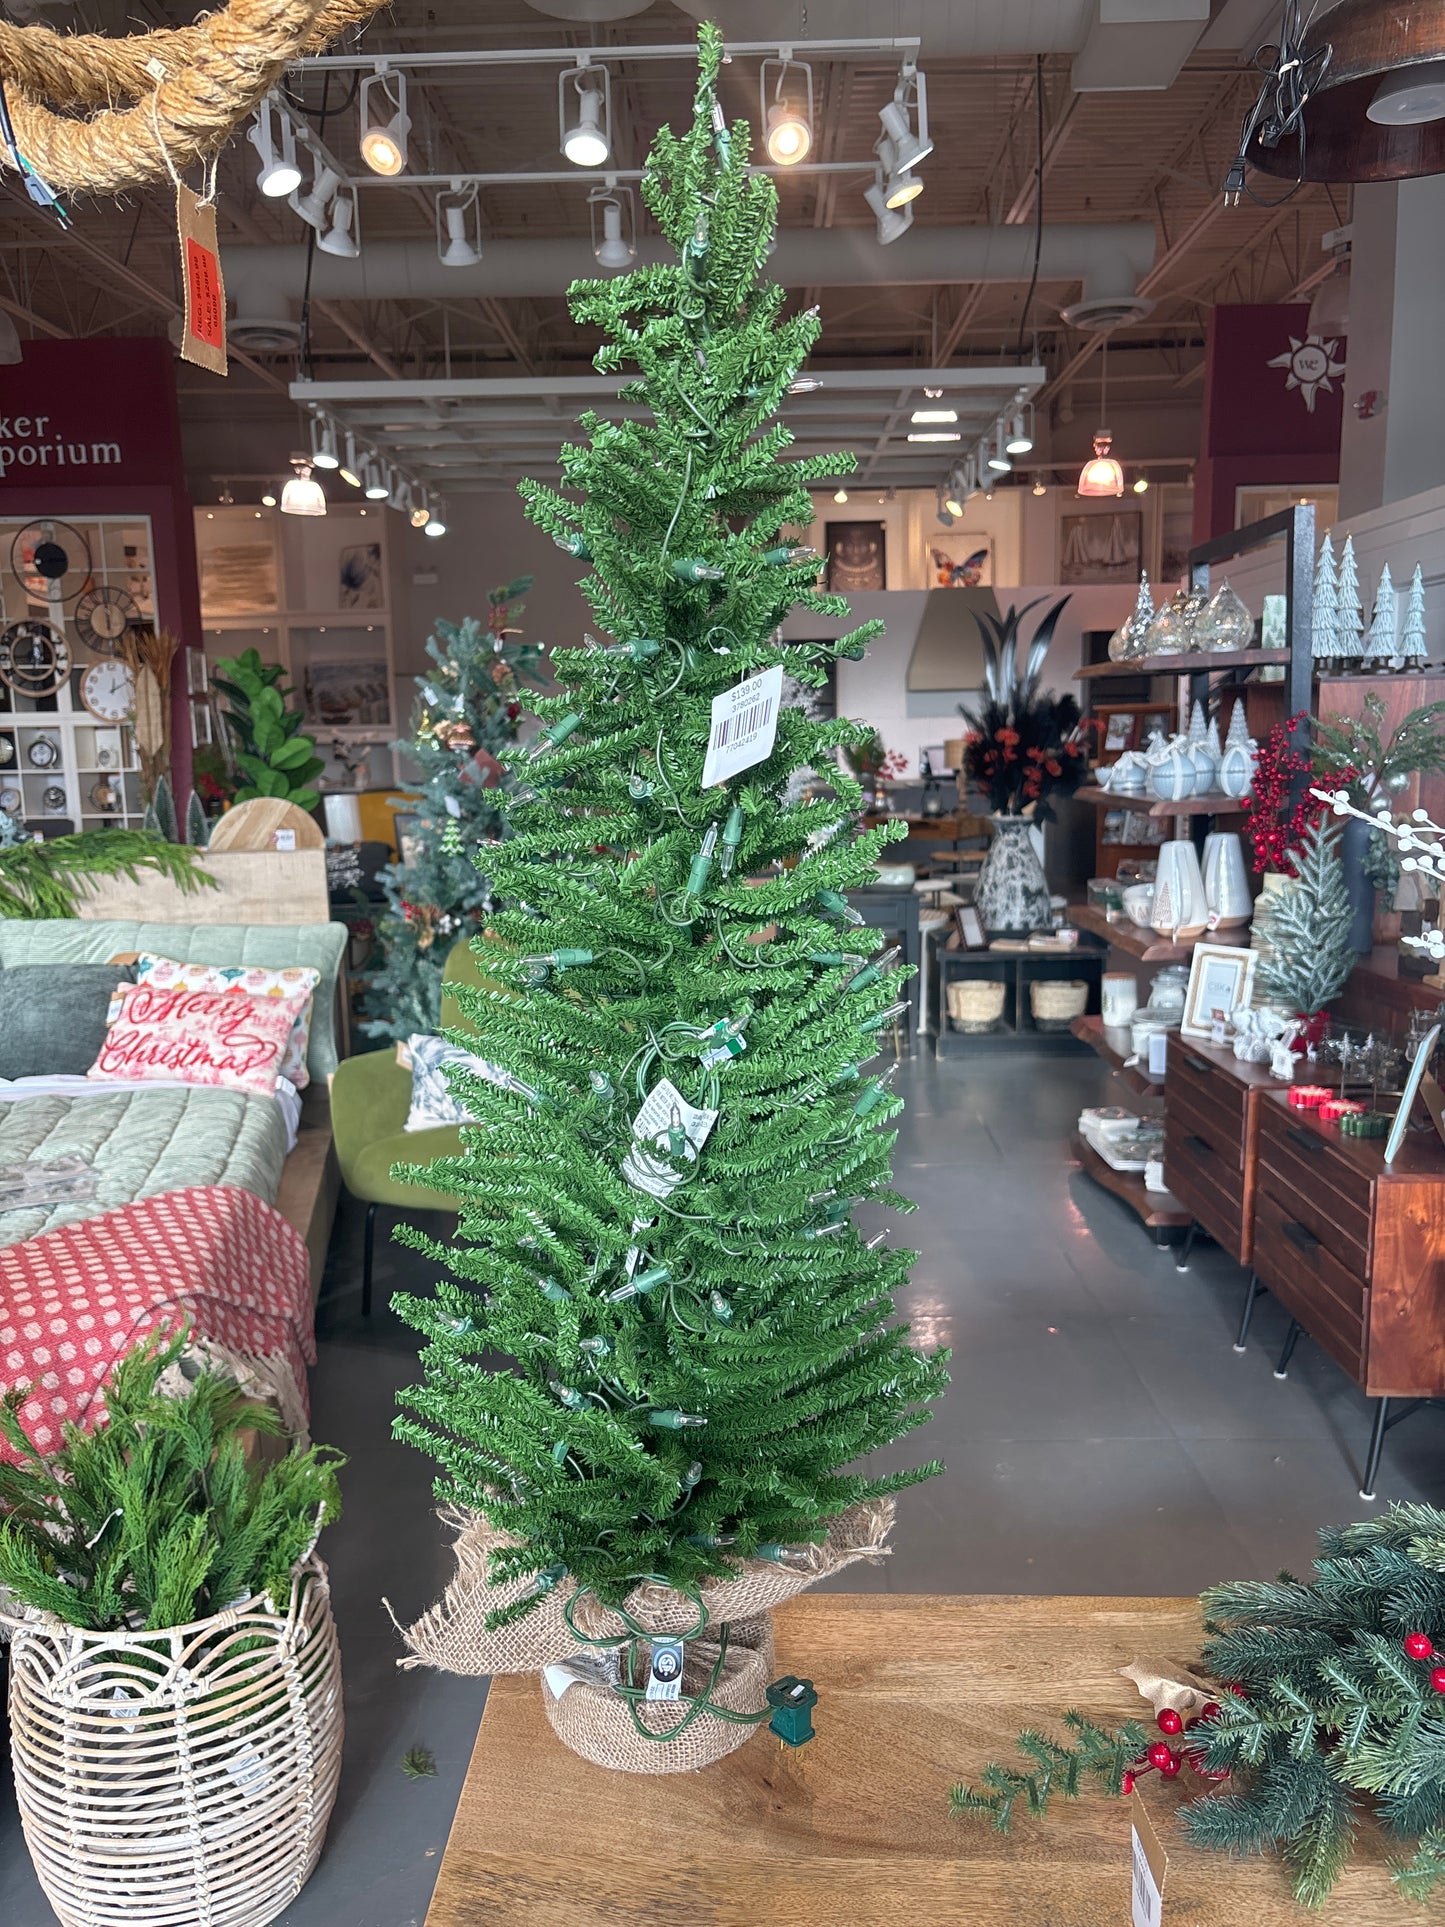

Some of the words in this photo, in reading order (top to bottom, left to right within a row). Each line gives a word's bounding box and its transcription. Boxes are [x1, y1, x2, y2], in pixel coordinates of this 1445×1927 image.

[0, 434, 122, 477] porium
[730, 678, 763, 702] $139.00
[129, 990, 254, 1034] Merry
[100, 1028, 278, 1076] Christmas
